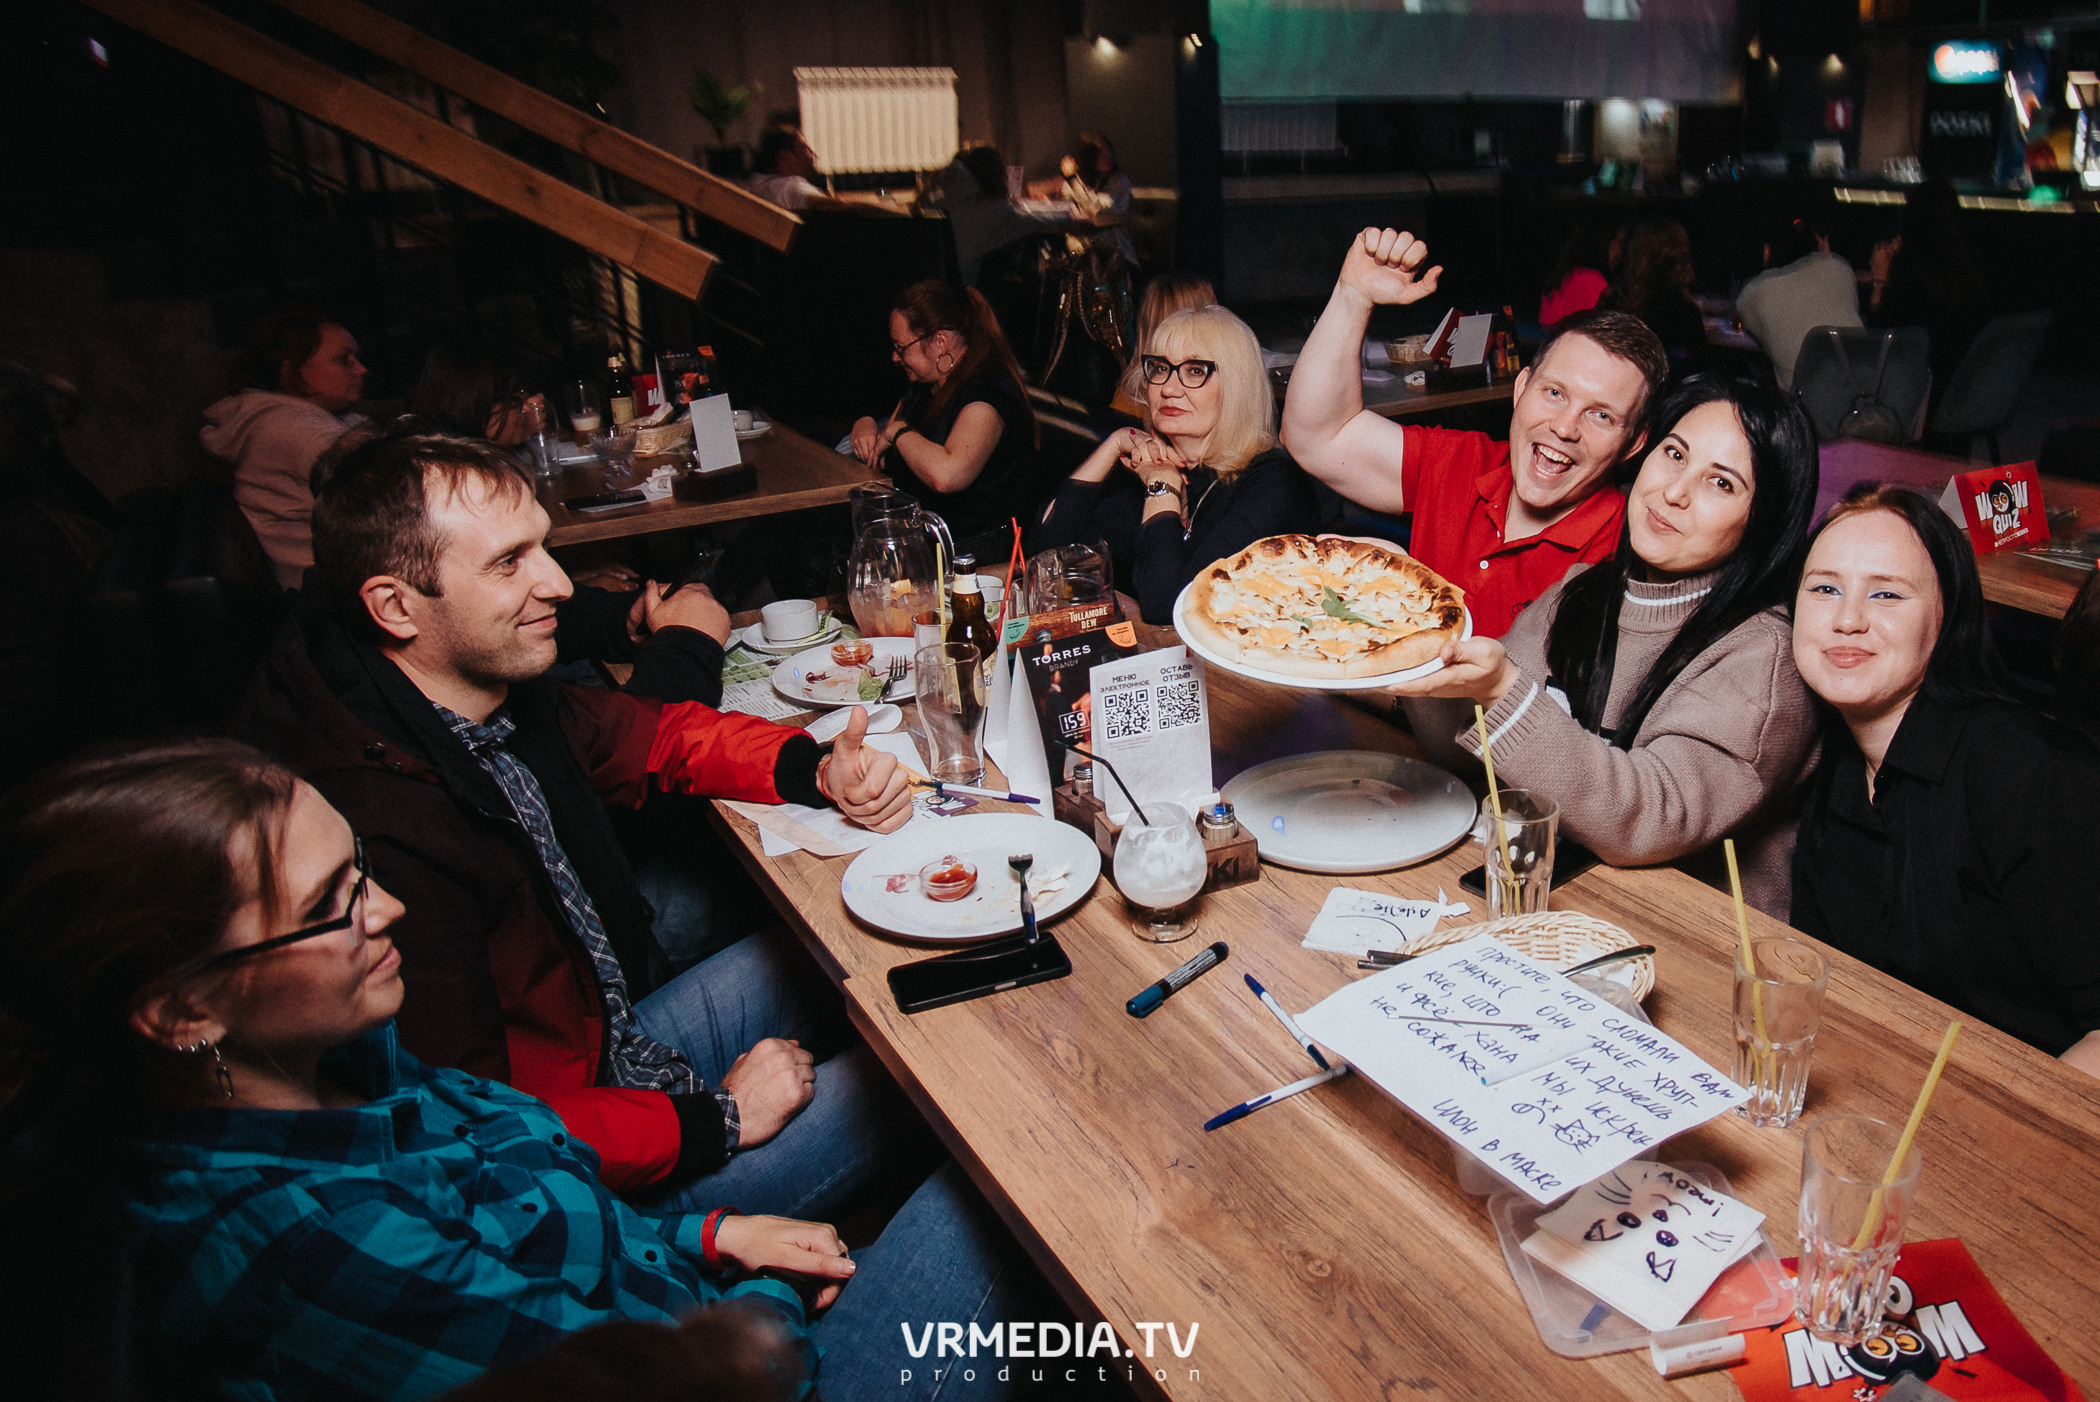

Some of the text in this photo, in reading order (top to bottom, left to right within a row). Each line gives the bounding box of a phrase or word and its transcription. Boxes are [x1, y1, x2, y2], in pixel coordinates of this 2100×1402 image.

[1993, 509, 2021, 535] QUIZ
[1068, 606, 1108, 623] TULLAMORE
[1081, 618, 1097, 629] DEW
[1032, 645, 1091, 666] TORRES
[1049, 659, 1079, 672] BRANDY
[1160, 663, 1194, 675] ОСТАВЬ
[1112, 673, 1137, 693] МЕНЮ
[1162, 671, 1191, 683] ОТЗЫВ
[1100, 679, 1150, 693] ЭЛЕКТРОННОЕ
[1064, 711, 1087, 731] 159
